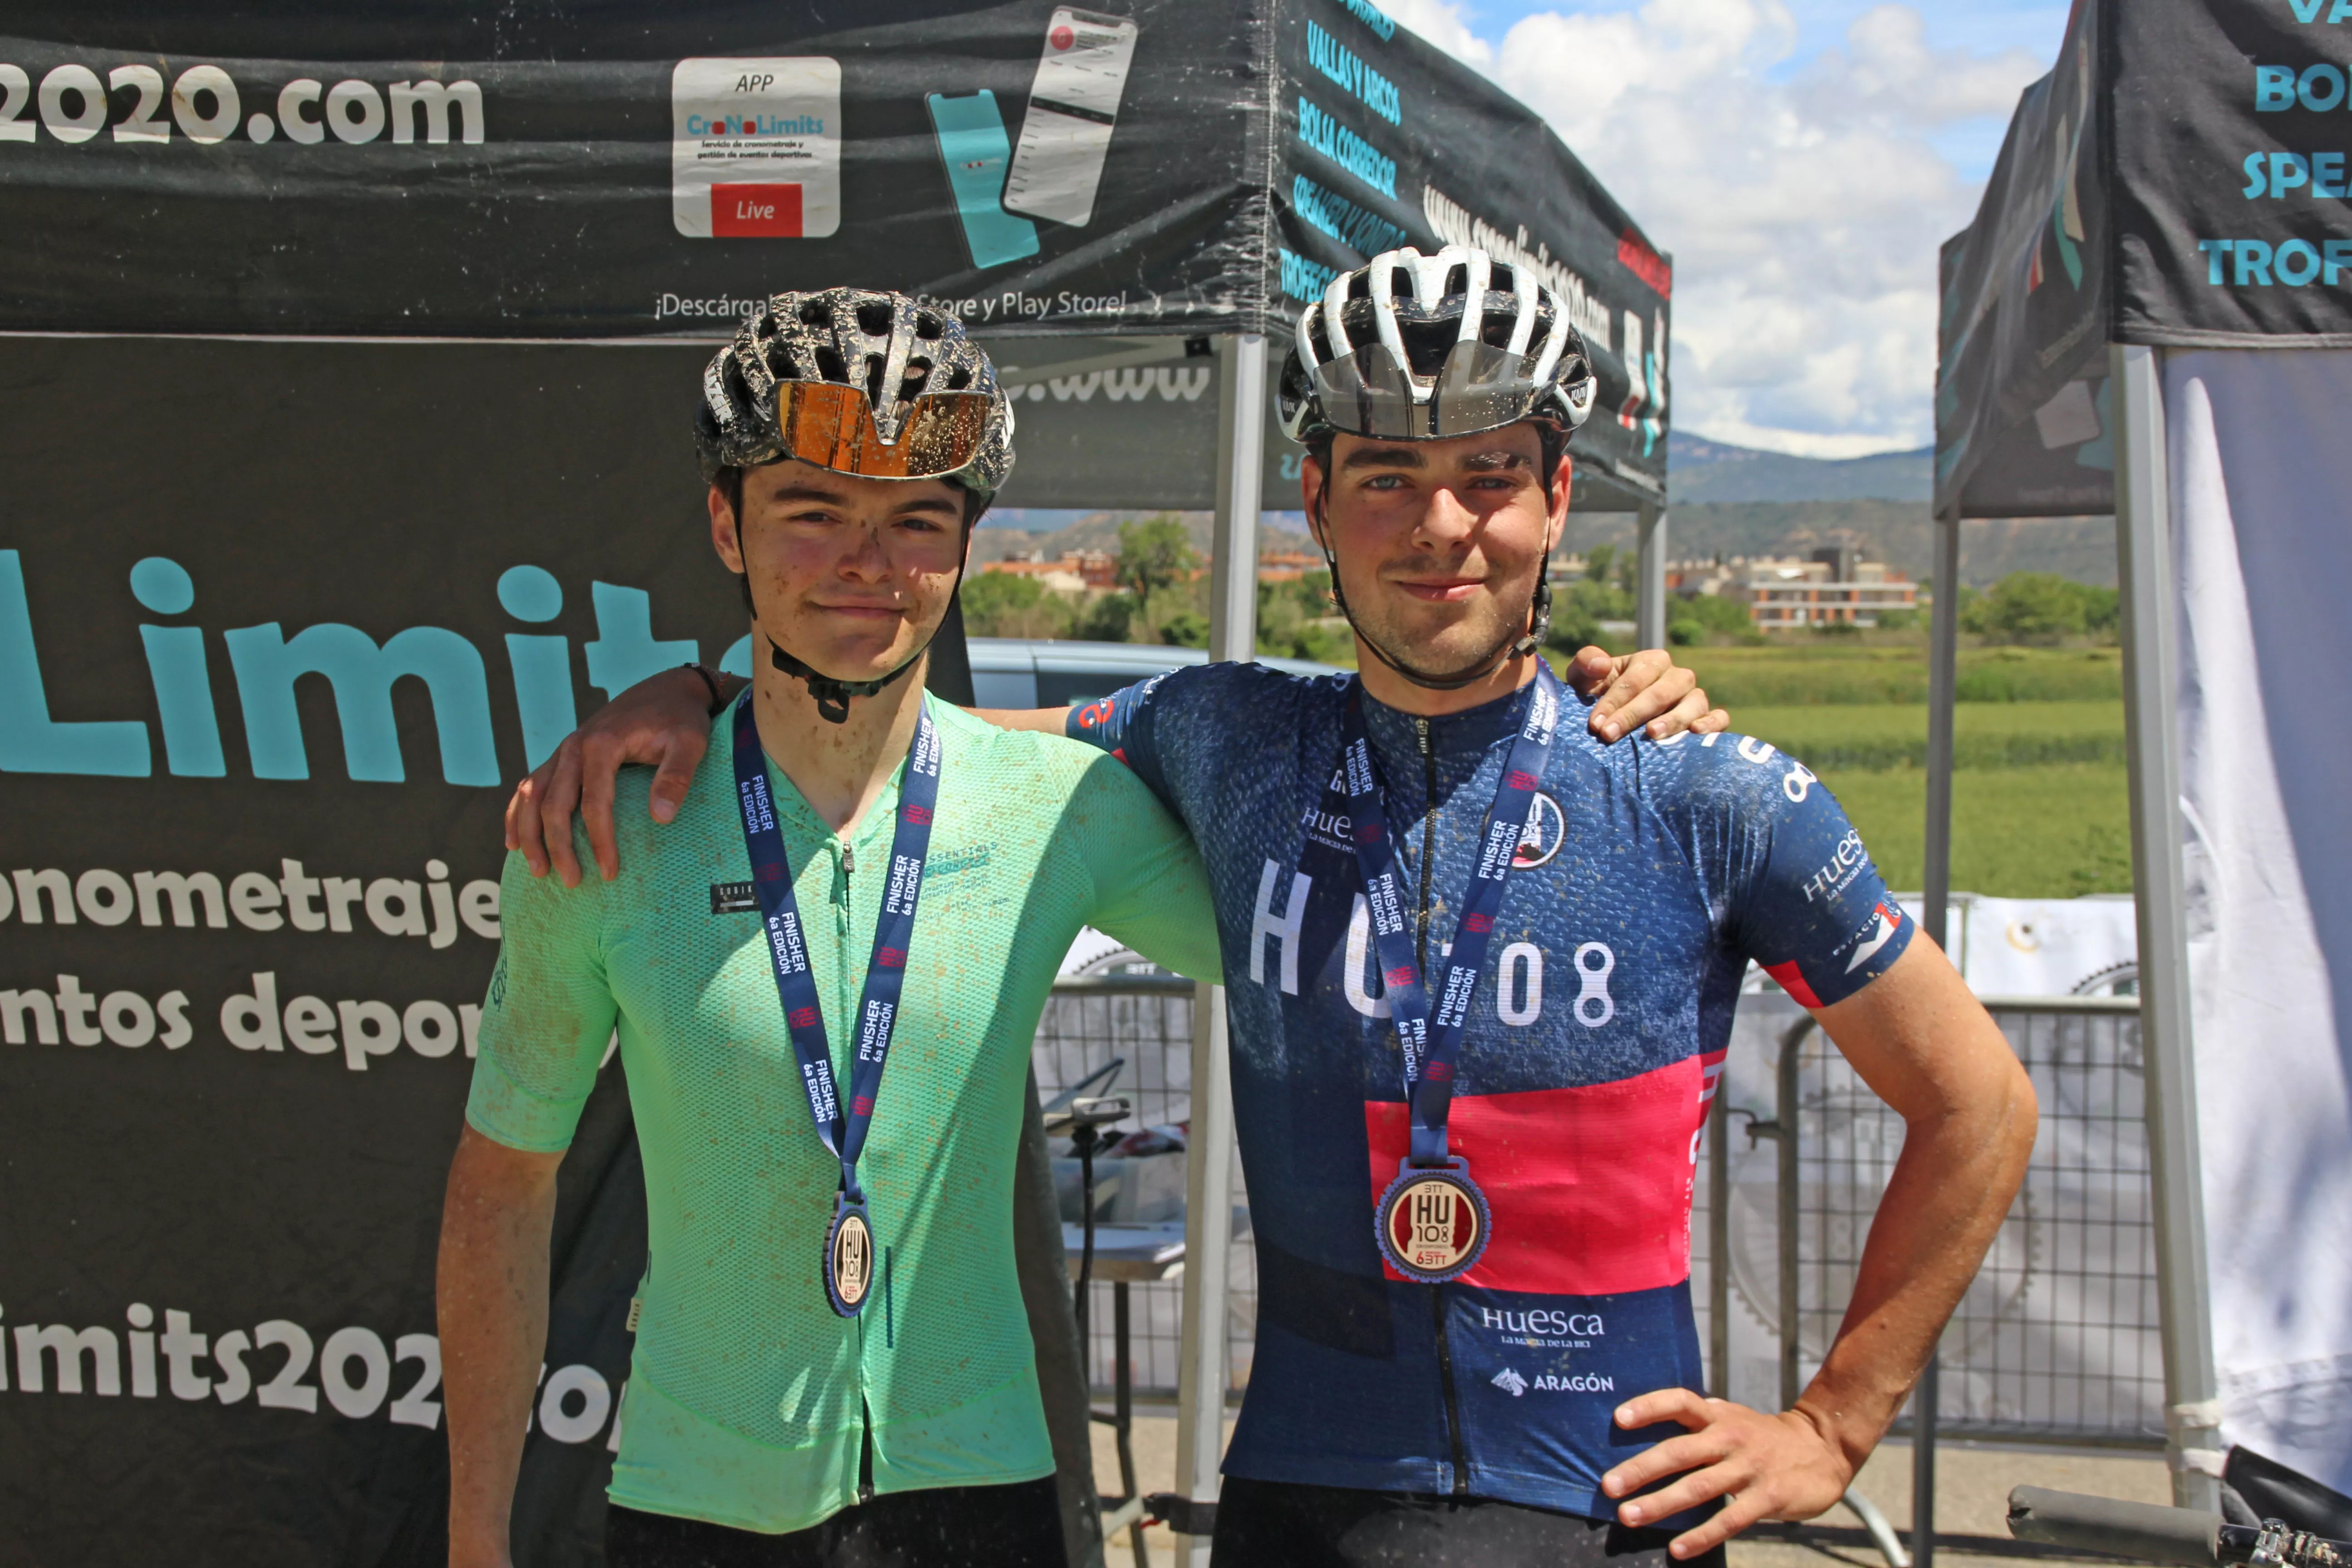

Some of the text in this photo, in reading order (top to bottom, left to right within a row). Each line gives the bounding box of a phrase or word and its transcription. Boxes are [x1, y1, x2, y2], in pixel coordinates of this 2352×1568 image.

[735, 75, 774, 92] APP
[1307, 19, 1352, 92] VALLAS
[1363, 64, 1401, 127] ARCOS
[2255, 64, 2352, 113] BO
[0, 64, 484, 144] 2020.com
[1298, 96, 1397, 201] BOLSA CORREDOR
[2242, 152, 2352, 200] SPE
[736, 201, 775, 220] Live
[982, 299, 997, 321] y
[1003, 292, 1051, 320] Play
[1058, 291, 1126, 314] Store!
[913, 717, 931, 774] FINISHER
[1355, 738, 1373, 794] FINISHER
[752, 774, 774, 832] FINISHER
[1478, 820, 1507, 879] FINISHER
[0, 858, 501, 949] nometraje
[720, 886, 752, 895] GOBIK
[886, 855, 909, 914] FINISHER
[1380, 872, 1403, 933] FINISHER
[782, 911, 805, 973] FINISHER
[1437, 965, 1464, 1026] FINISHER
[860, 1000, 881, 1061] FINISHER
[815, 1059, 838, 1121] FINISHER
[1416, 1225, 1449, 1243] 108
[1417, 1195, 1450, 1224] HU
[846, 1230, 860, 1259] HU
[1534, 1372, 1614, 1392] ARAGÓN
